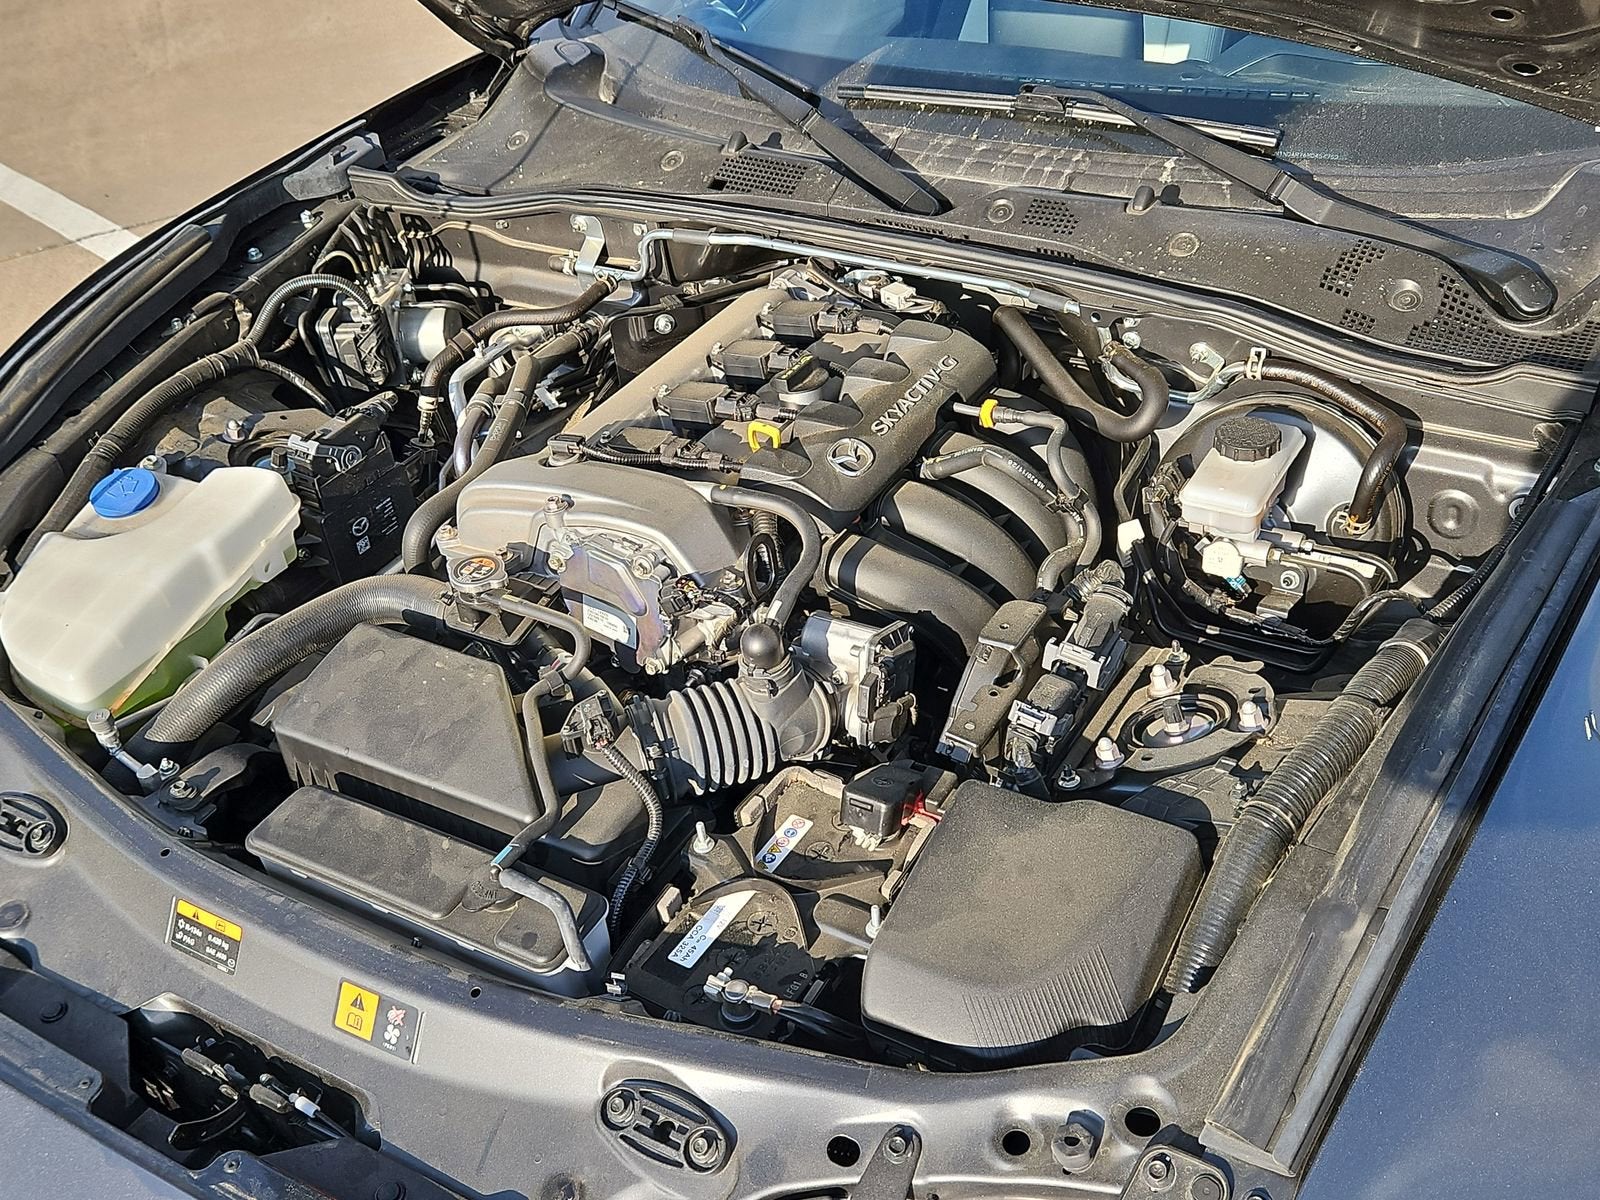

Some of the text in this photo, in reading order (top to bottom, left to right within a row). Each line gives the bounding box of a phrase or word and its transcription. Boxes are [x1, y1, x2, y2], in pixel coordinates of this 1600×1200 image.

[871, 355, 959, 436] SKYACTIV-G
[671, 925, 703, 957] CCA 325A
[679, 945, 697, 962] 45Ah
